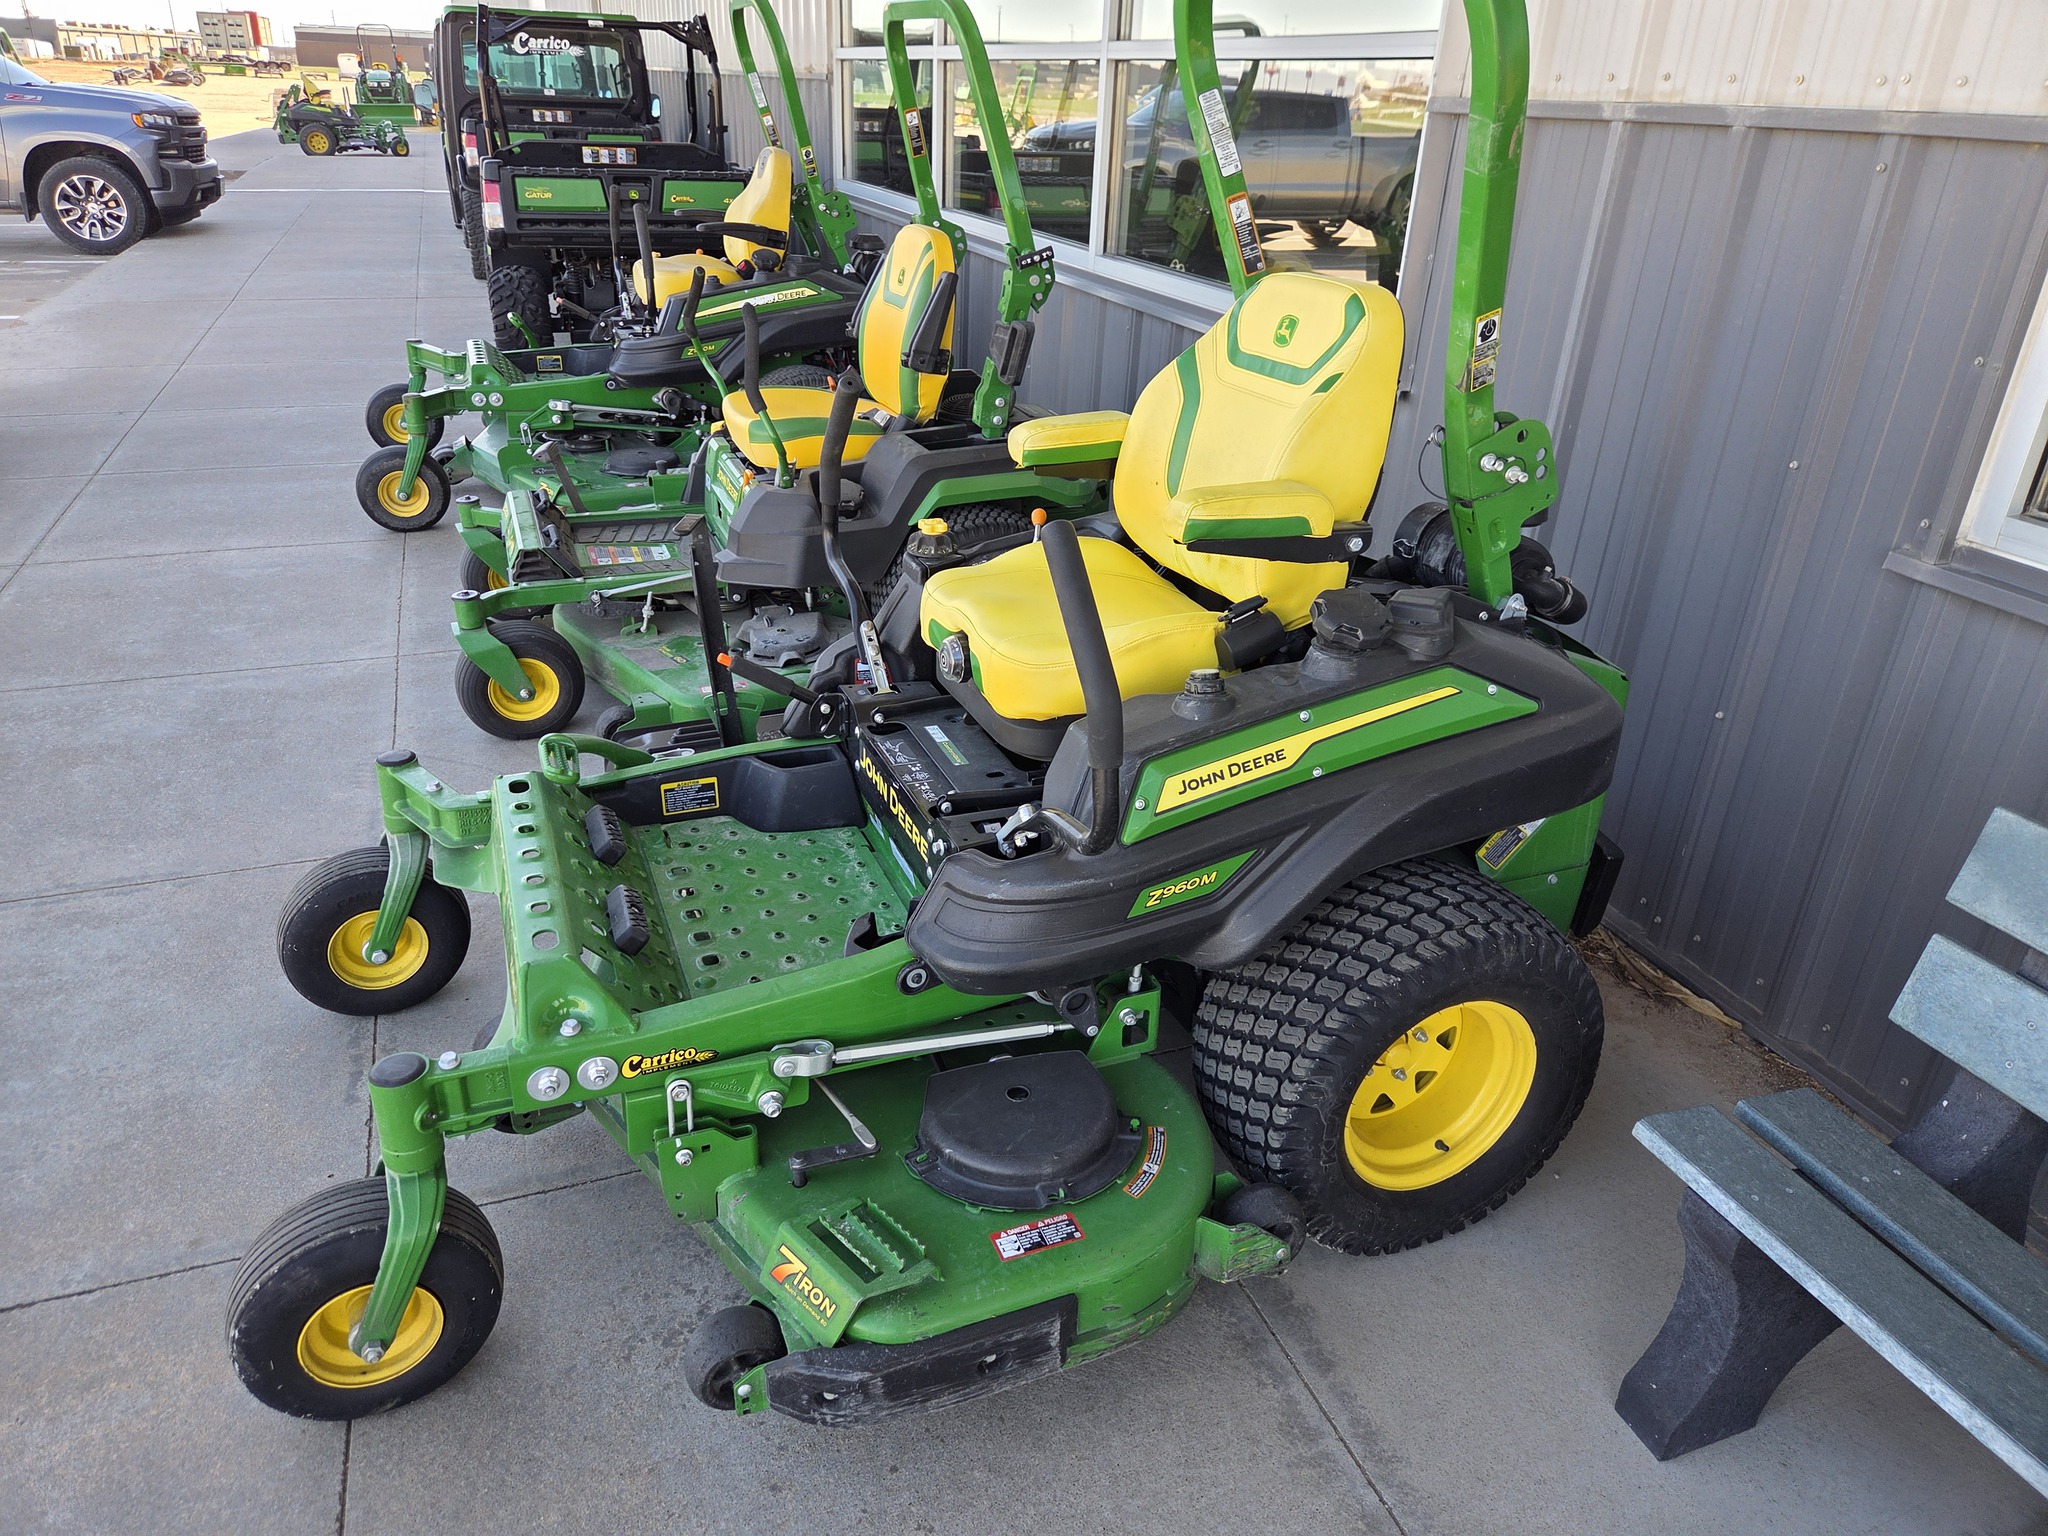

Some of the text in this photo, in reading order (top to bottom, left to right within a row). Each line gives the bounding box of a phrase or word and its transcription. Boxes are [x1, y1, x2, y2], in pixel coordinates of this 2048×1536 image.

[513, 32, 570, 54] Carrico
[525, 191, 552, 199] GATOR
[777, 289, 806, 300] DEERE
[1178, 748, 1287, 795] JOHN DEERE
[860, 747, 929, 863] JOHN DEERE
[1145, 870, 1218, 907] Z960M
[621, 1047, 697, 1079] Carrico
[642, 1060, 693, 1074] IMPLEMENT
[1007, 1213, 1068, 1235] DANGER PELIGRO
